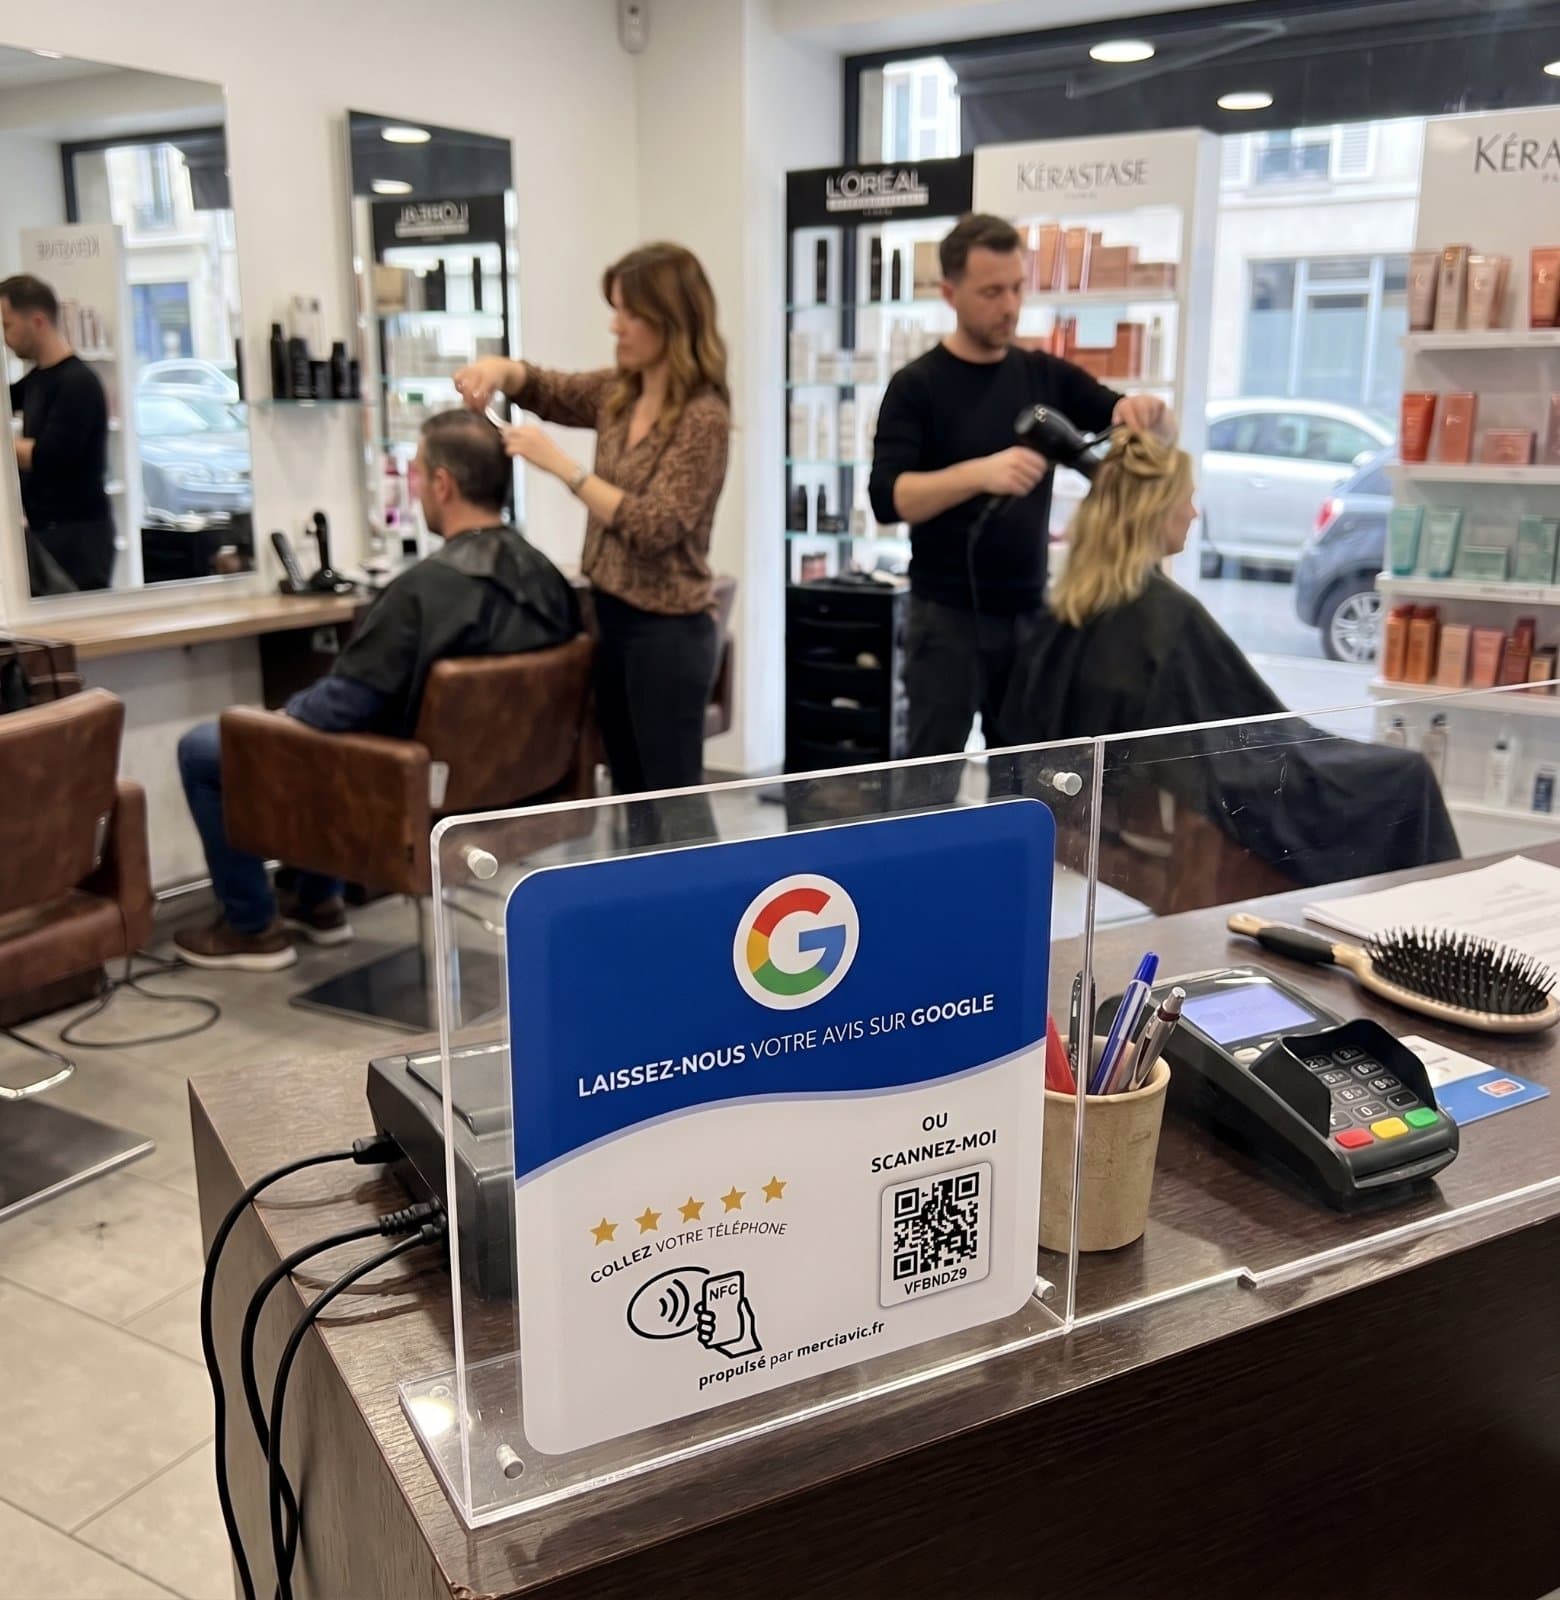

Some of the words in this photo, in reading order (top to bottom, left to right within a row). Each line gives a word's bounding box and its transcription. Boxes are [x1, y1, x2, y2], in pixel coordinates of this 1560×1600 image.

[1017, 157, 1148, 192] KÉRASTASE
[578, 1045, 746, 1098] LAISSEZ-NOUS
[750, 1030, 817, 1060] VOTRE
[822, 1020, 864, 1046] AVIS
[869, 1012, 906, 1036] SUR
[911, 993, 994, 1026] GOOGLE
[922, 1112, 948, 1132] OU
[871, 1129, 996, 1173] SCANNEZ-MOI
[590, 1245, 652, 1283] COLLEZ
[655, 1229, 703, 1253] VOTRE
[707, 1220, 788, 1239] TÉLÉPHONE
[709, 1283, 738, 1301] NFC
[904, 1267, 967, 1296] VFBNDZ9
[699, 1356, 766, 1390] propulsé
[770, 1349, 793, 1370] par
[797, 1320, 885, 1358] merciavic.fr
